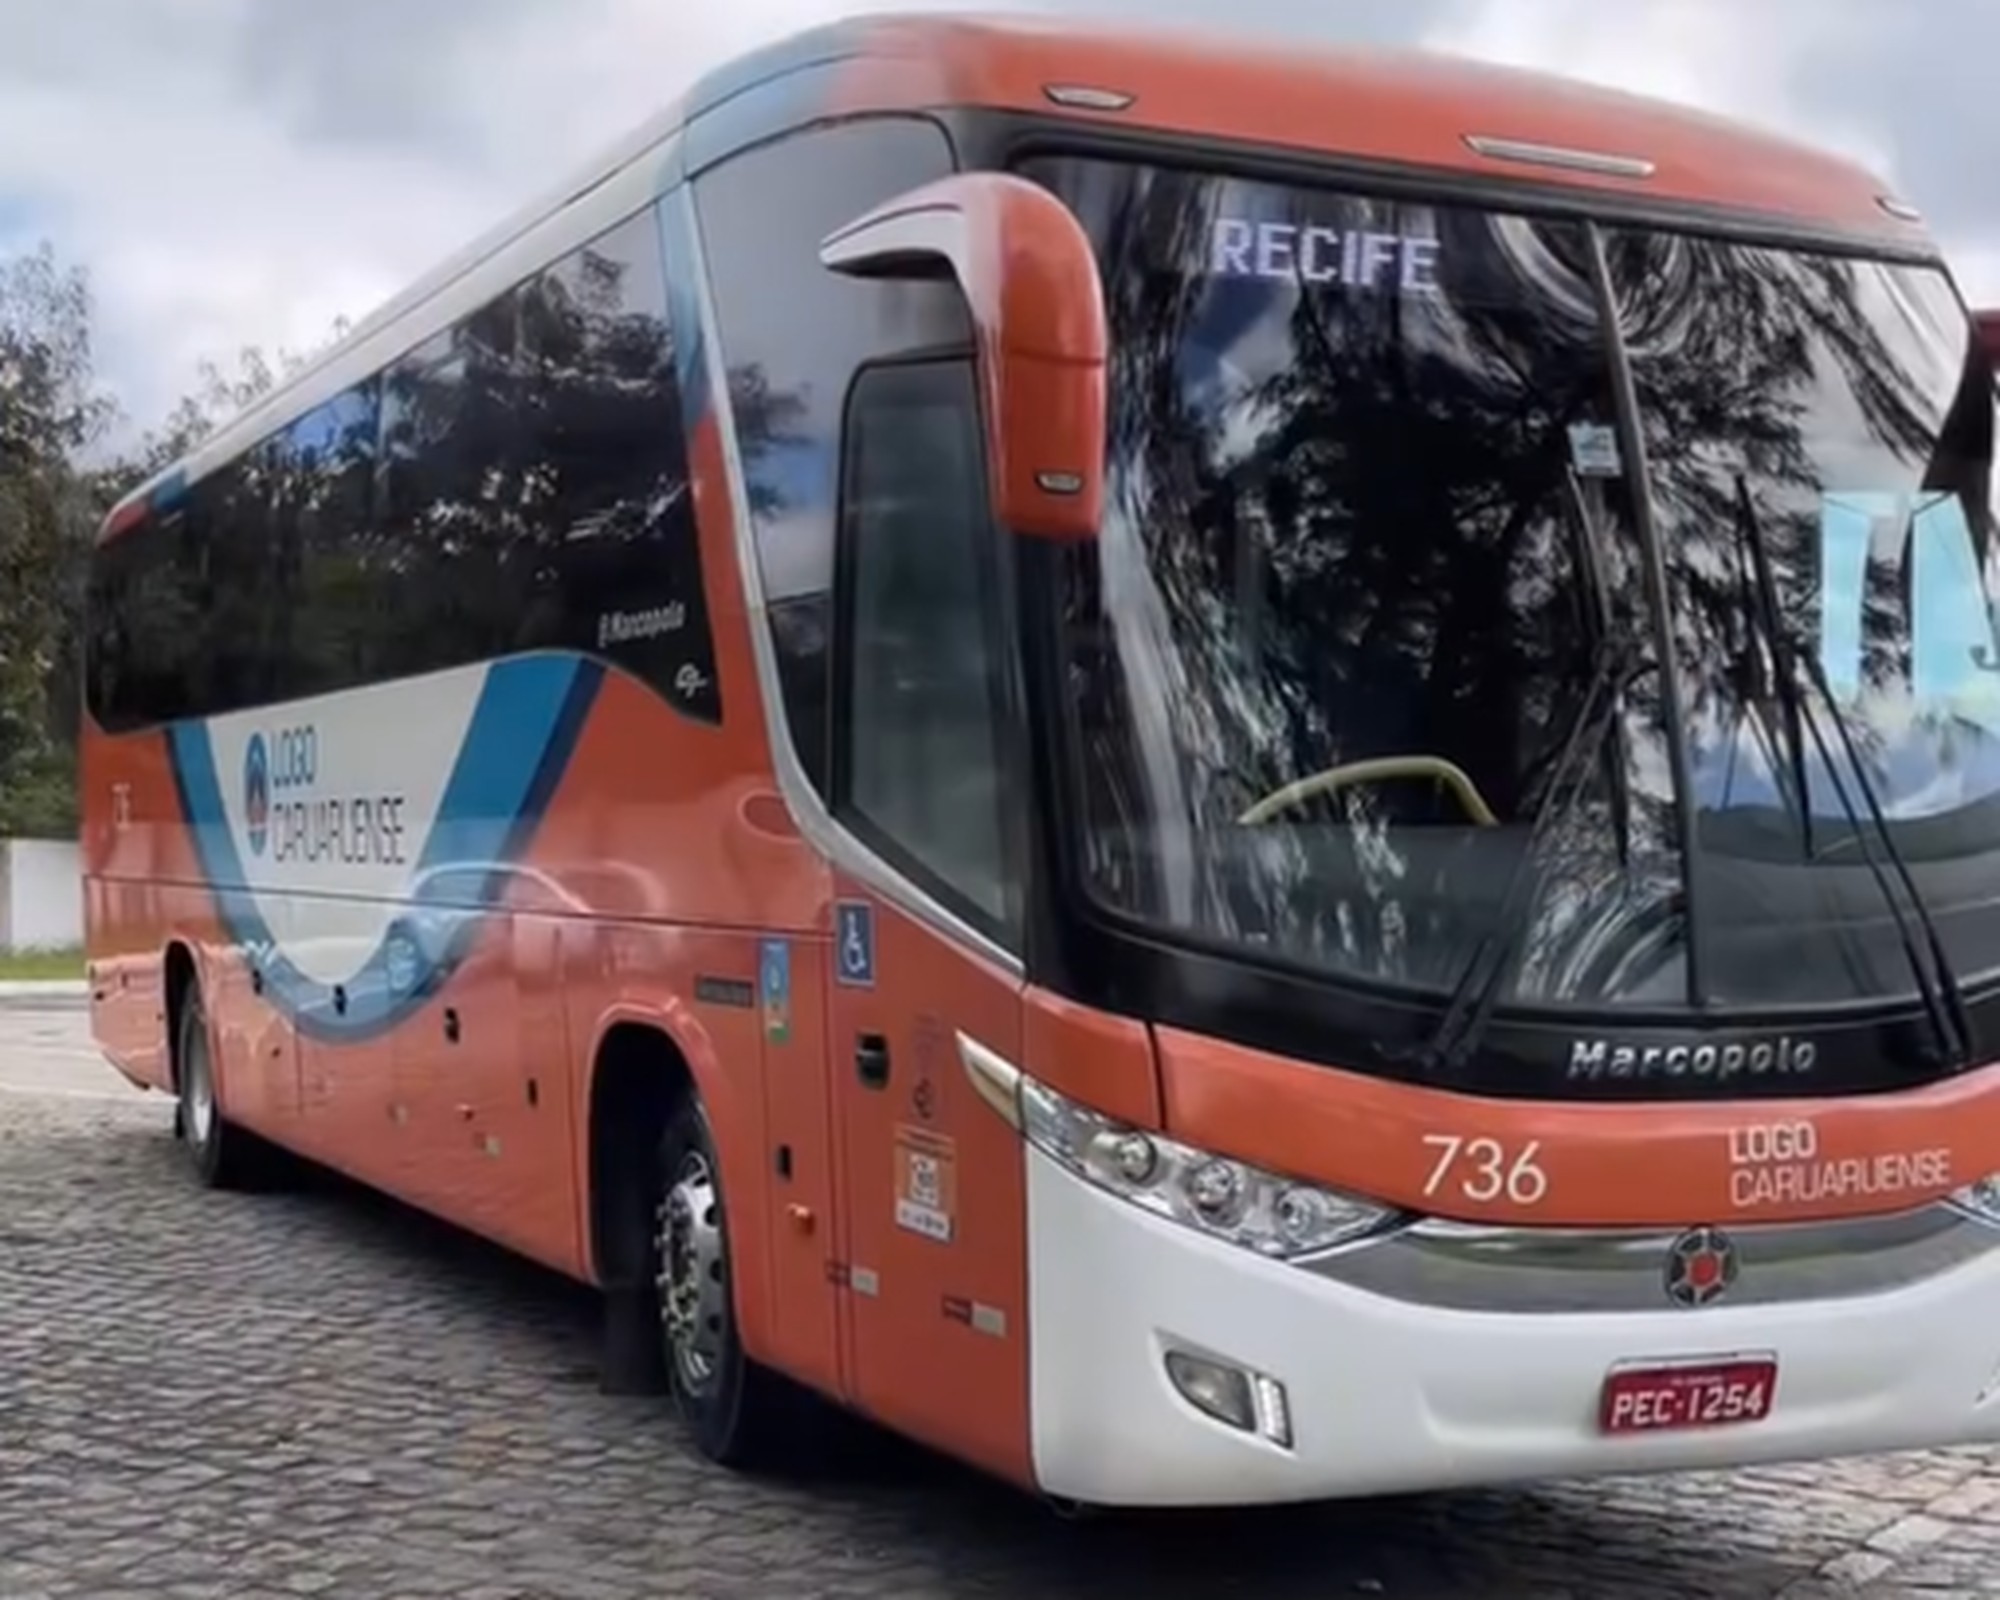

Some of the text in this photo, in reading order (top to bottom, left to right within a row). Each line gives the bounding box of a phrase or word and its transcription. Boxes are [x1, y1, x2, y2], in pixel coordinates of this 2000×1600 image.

[1212, 217, 1440, 292] RECIFE
[271, 724, 317, 788] LOGO
[1567, 1036, 1816, 1080] Marcopolo
[1422, 1134, 1547, 1204] 736
[1729, 1120, 1817, 1164] LOGO
[1731, 1148, 1951, 1208] CARUARUENSE
